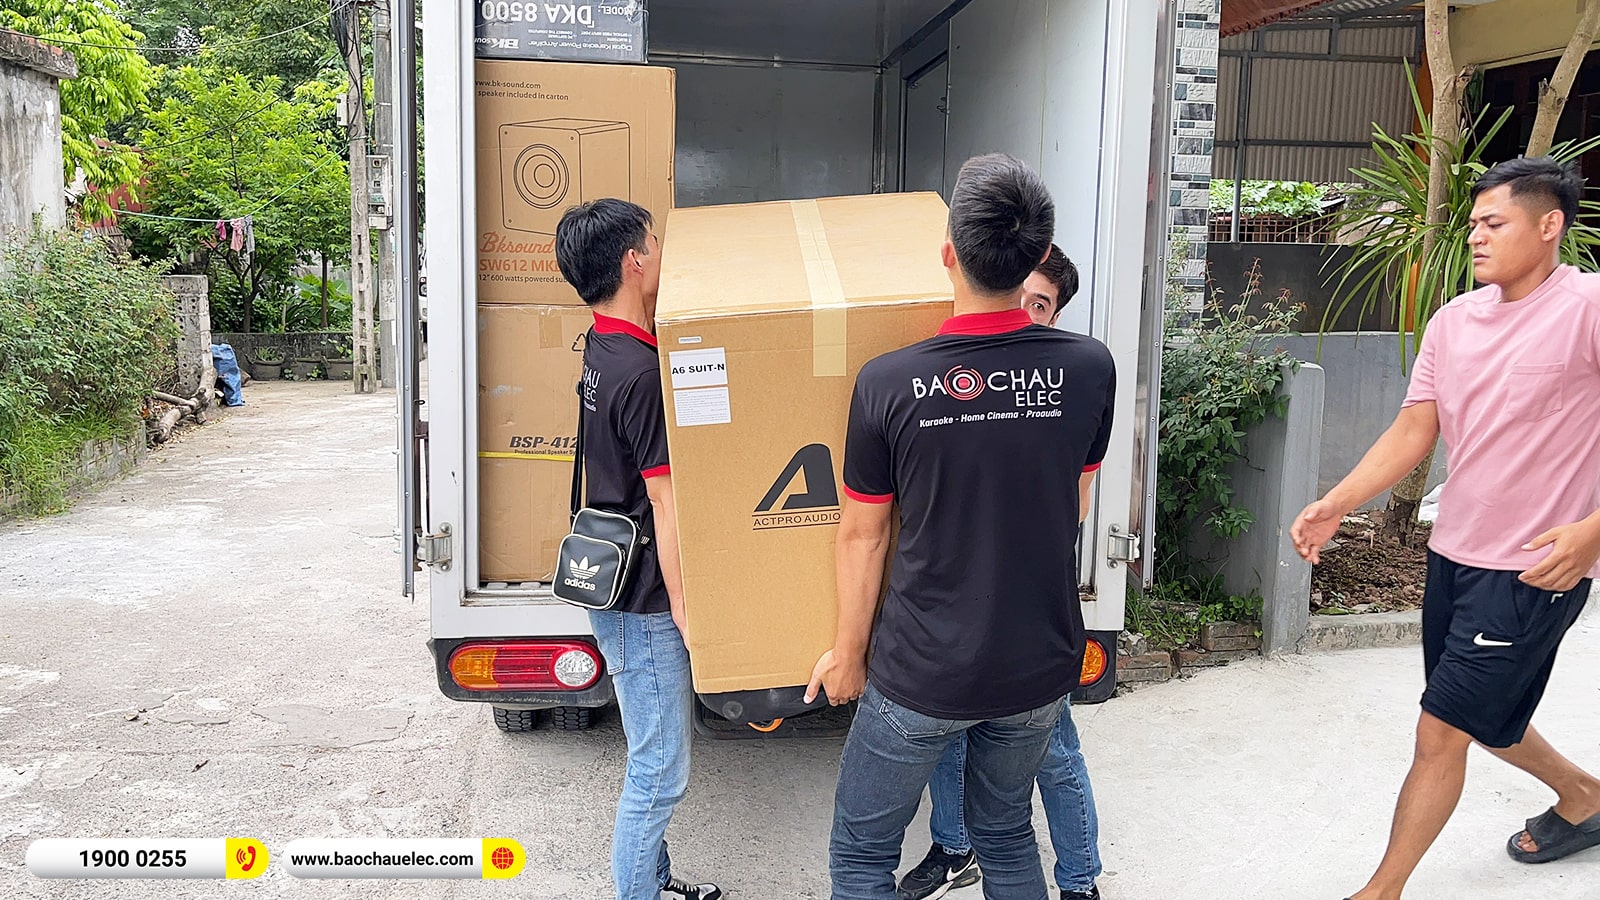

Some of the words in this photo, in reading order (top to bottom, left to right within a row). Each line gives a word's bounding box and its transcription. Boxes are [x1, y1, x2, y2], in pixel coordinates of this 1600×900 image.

[481, 0, 537, 21] 8500
[544, 3, 591, 25] DKA
[478, 90, 505, 98] speaker
[506, 91, 536, 99] included
[546, 93, 569, 101] carton
[480, 259, 528, 272] SW612
[490, 274, 504, 282] 600
[504, 274, 524, 282] watts
[524, 275, 554, 283] powered
[672, 366, 686, 375] A6
[688, 363, 725, 373] SUIT-N
[1015, 390, 1062, 407] ELEC
[919, 416, 954, 428] Karaoke
[960, 412, 985, 423] Home
[986, 411, 1019, 421] Cinema
[1025, 408, 1062, 419] Proaudio
[753, 515, 802, 527] ACTPRO
[804, 512, 840, 523] AUDIO
[564, 577, 596, 591] adidas
